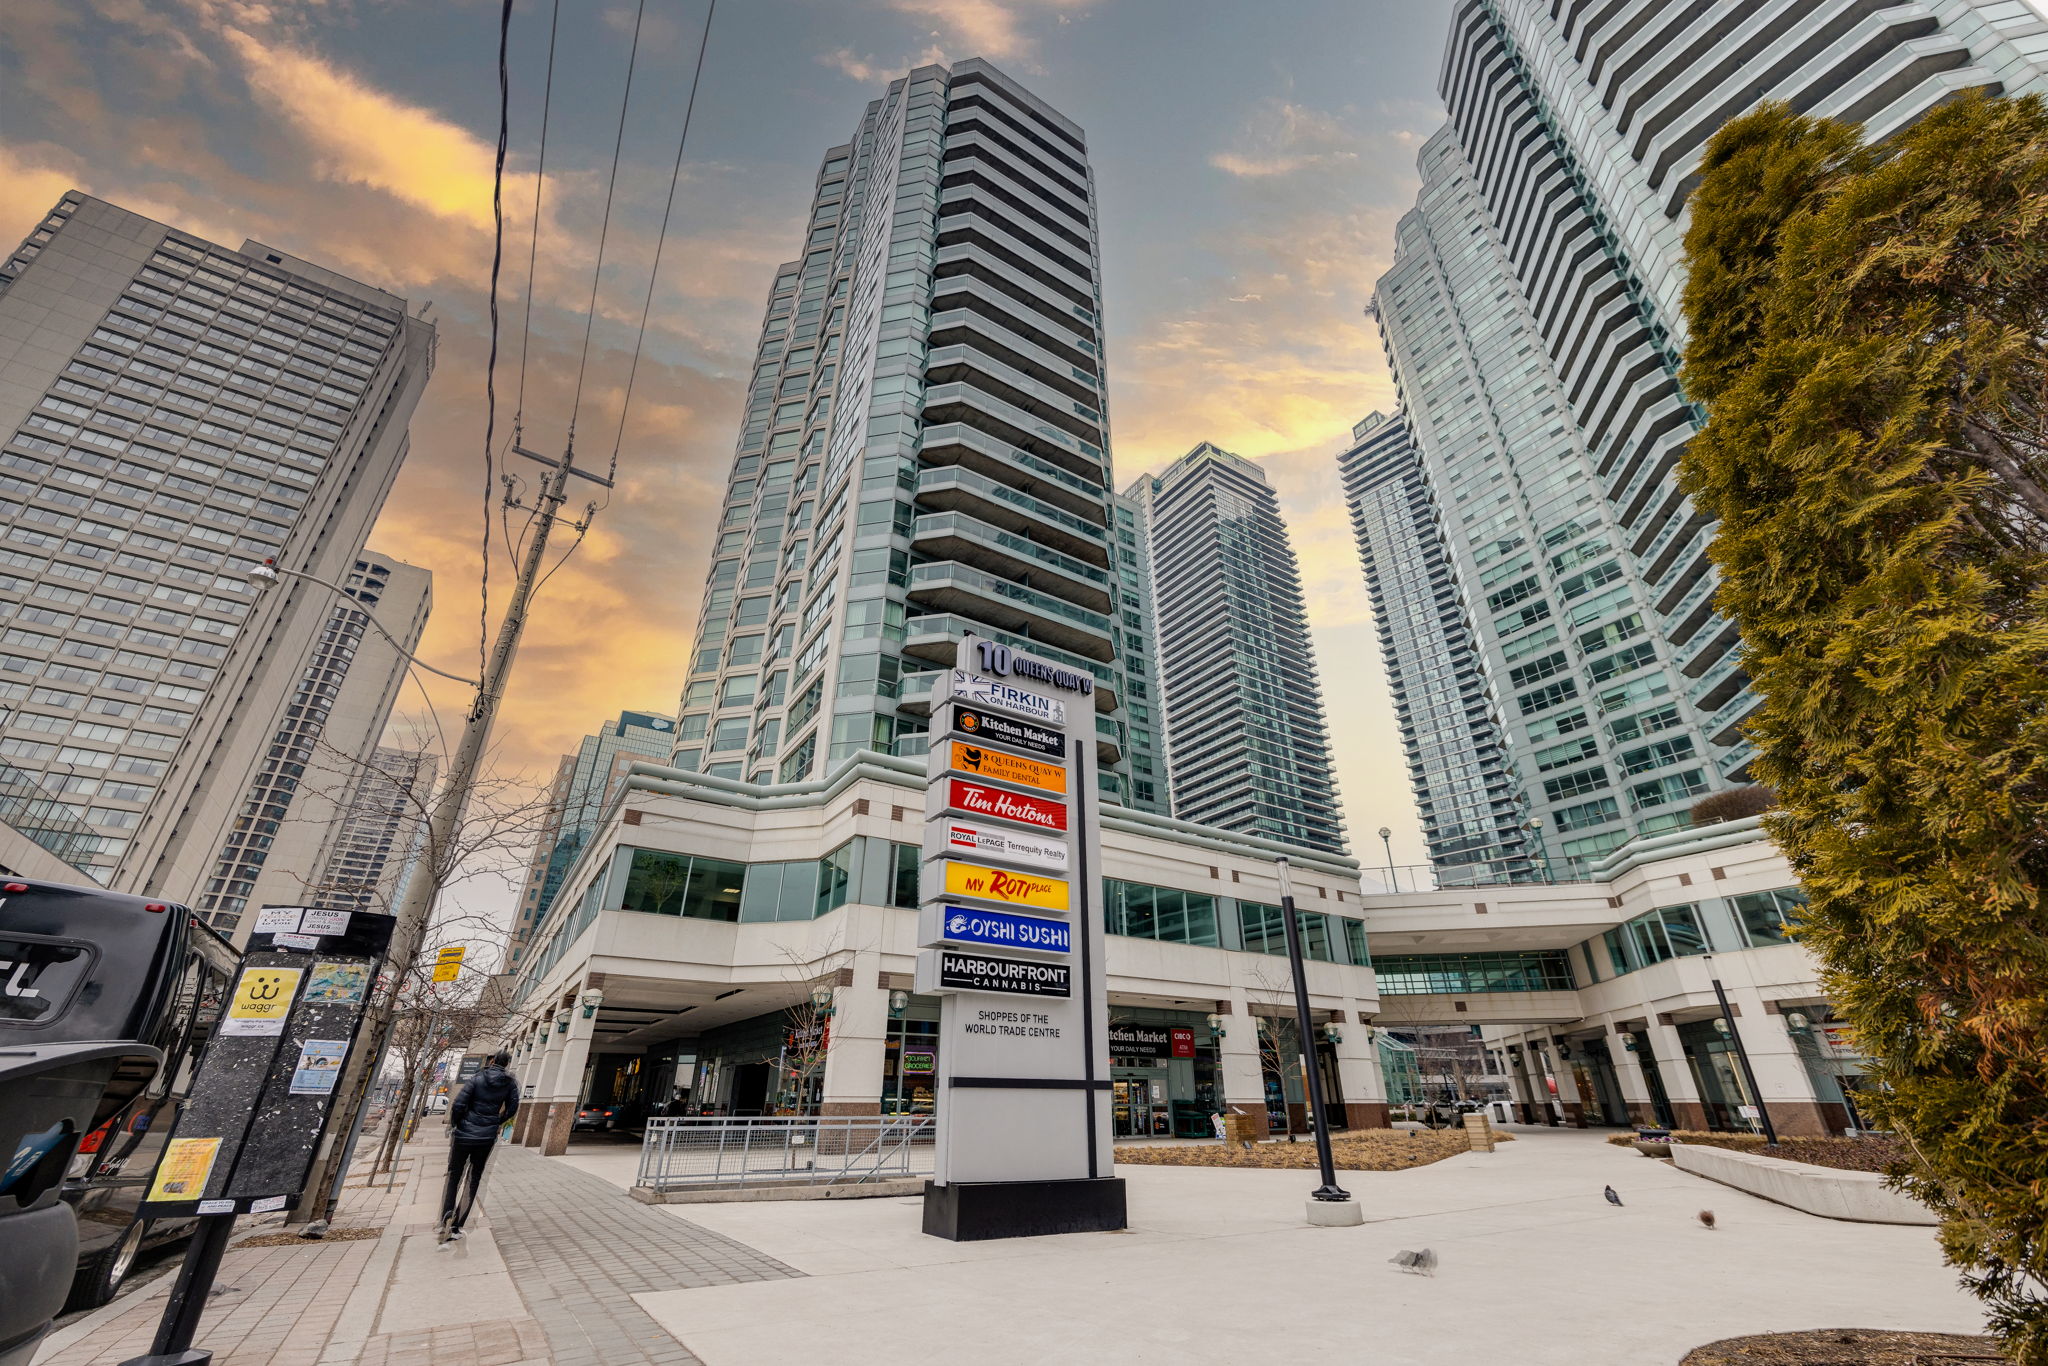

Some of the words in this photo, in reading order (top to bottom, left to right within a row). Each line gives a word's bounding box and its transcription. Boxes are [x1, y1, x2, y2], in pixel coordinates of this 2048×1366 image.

[977, 641, 1012, 677] 10
[1013, 657, 1053, 682] QUEENS
[1054, 669, 1081, 690] QUAY
[1081, 678, 1093, 695] W
[990, 696, 1003, 705] ON
[1006, 702, 1049, 718] HARBOUR
[991, 683, 1049, 711] FIRKIN
[981, 716, 1022, 737] Kitchen
[1024, 727, 1058, 746] Market
[995, 733, 1011, 741] YOUR
[1012, 737, 1027, 745] DAILY
[1027, 741, 1046, 751] NEEDS
[983, 765, 1010, 777] FAMILY
[1012, 771, 1041, 785] DENTAL
[991, 755, 1027, 770] QUEENS
[1029, 763, 1051, 776] QUAY
[1055, 769, 1062, 777] W
[963, 787, 992, 812] Tim
[994, 794, 1055, 825] Hortons
[950, 832, 976, 843] ROYAL
[1007, 841, 1042, 856] Terrequity
[1044, 848, 1065, 860] Realty
[965, 878, 984, 891] MY
[989, 871, 1031, 900] ROTI
[1031, 883, 1052, 893] PLACE
[971, 918, 1015, 940] OYSHI
[1019, 924, 1068, 947] SUSHI
[944, 957, 1067, 983] HARBOURFRONT
[973, 977, 1040, 991] CANNABIS
[241, 1003, 277, 1013] waggr
[978, 1010, 1018, 1023] SHOPPES
[1021, 1014, 1031, 1023] OF
[1033, 1014, 1048, 1024] THE
[965, 1023, 997, 1035] WORLD
[999, 1026, 1026, 1037] TRADE
[1028, 1027, 1060, 1038] CENTRE
[1109, 1029, 1135, 1042] tchen
[1136, 1030, 1168, 1043] Market
[1140, 1046, 1156, 1054] NEEDS
